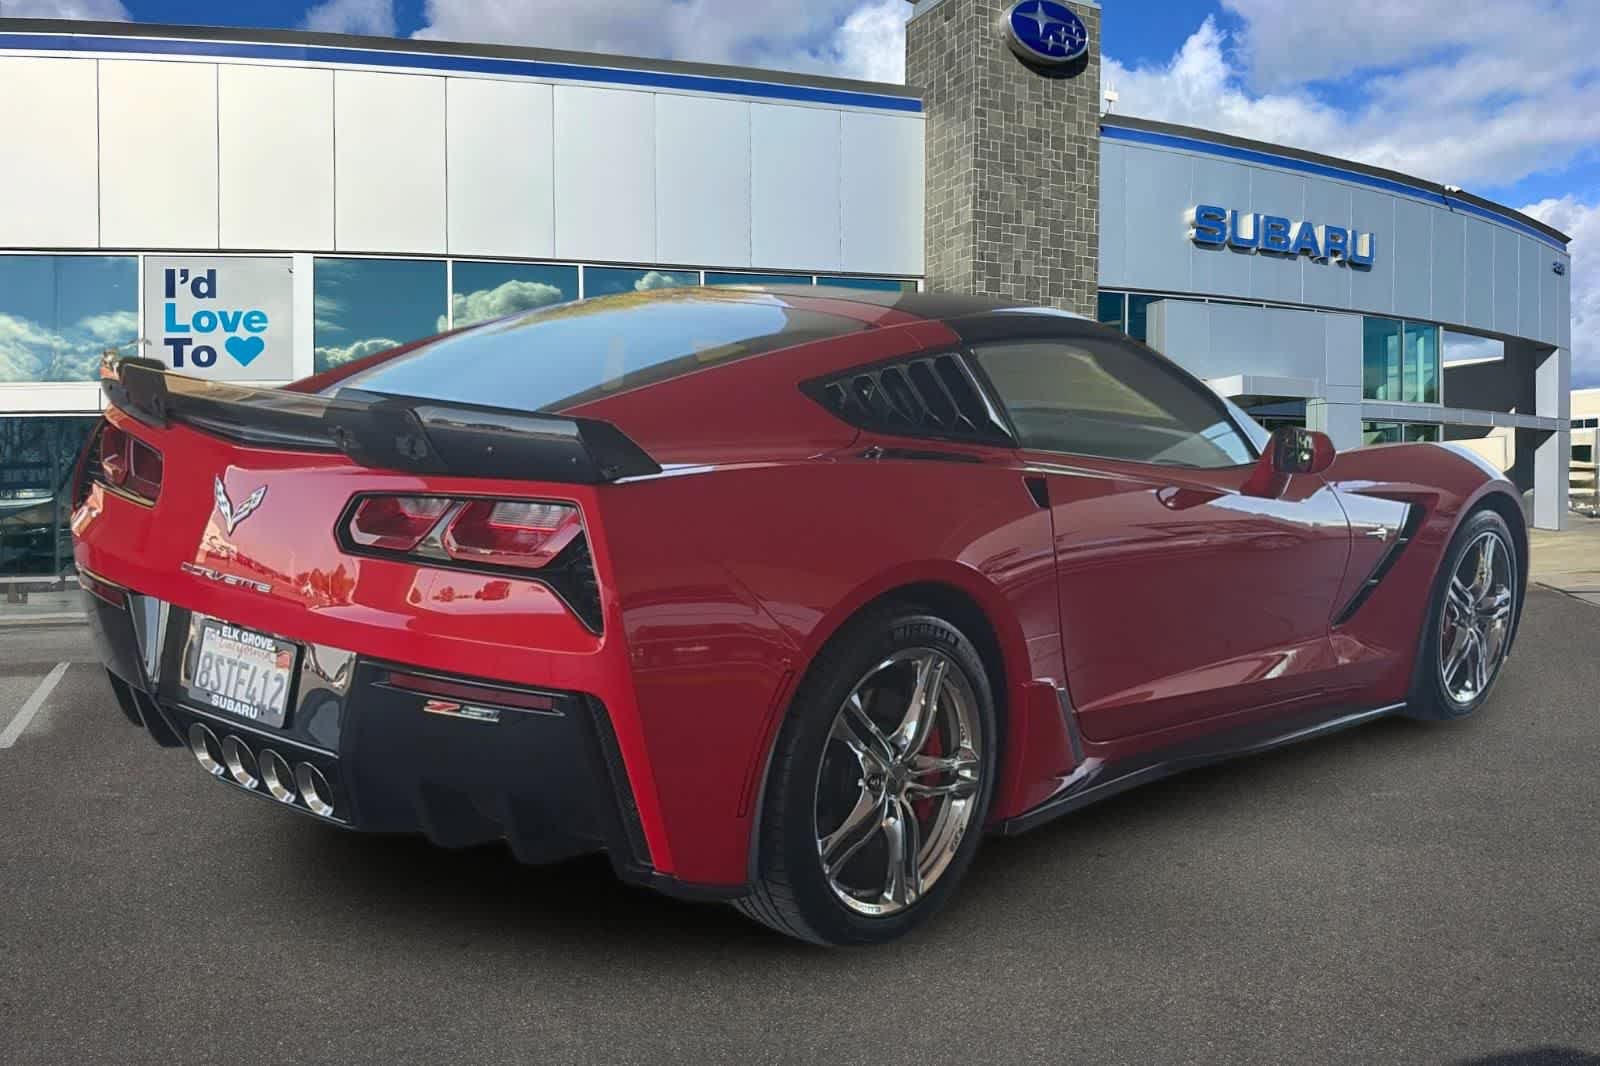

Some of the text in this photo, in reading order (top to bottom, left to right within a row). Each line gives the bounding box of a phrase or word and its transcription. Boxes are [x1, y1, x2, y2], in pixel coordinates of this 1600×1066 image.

[1191, 204, 1376, 268] SUBARU
[165, 268, 216, 299] I'd
[165, 302, 268, 334] Love
[164, 337, 217, 368] To
[222, 625, 241, 641] ELK
[242, 631, 273, 651] GROVE
[198, 652, 285, 714] 8STF412
[211, 693, 258, 719] SUBARU
